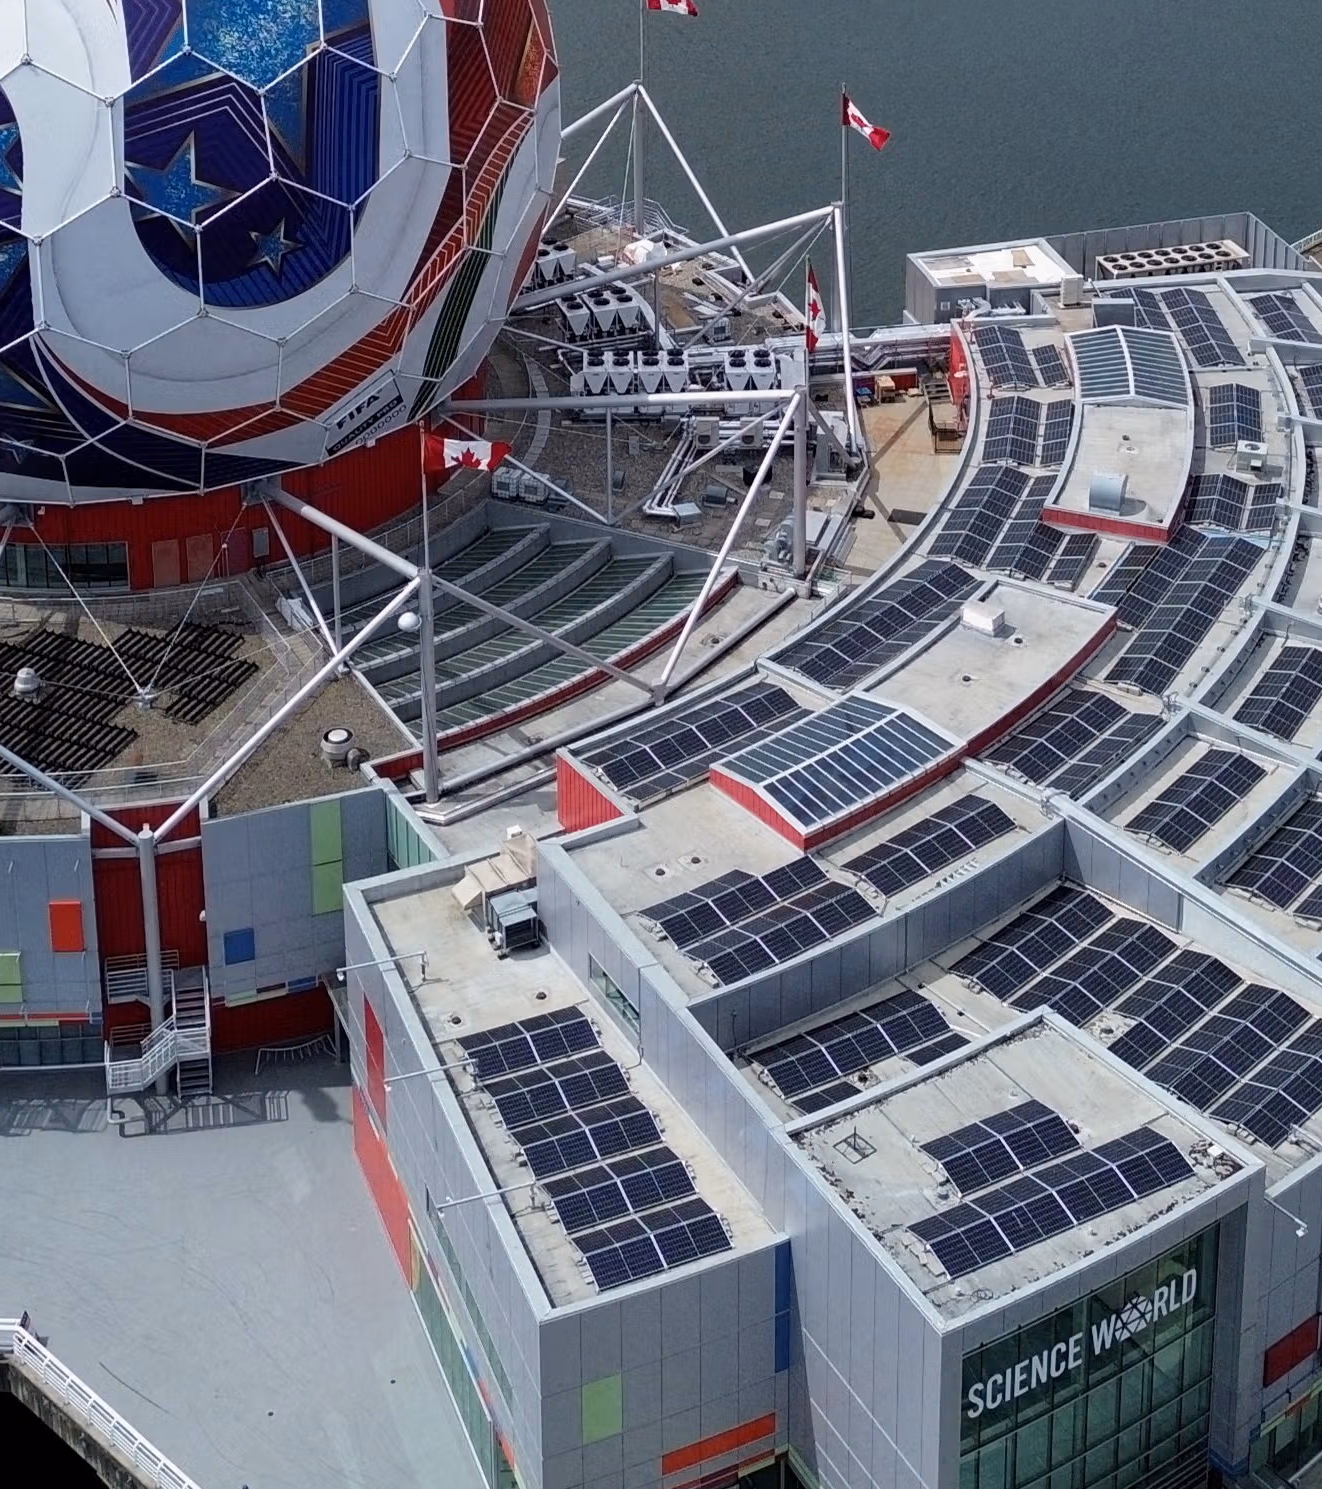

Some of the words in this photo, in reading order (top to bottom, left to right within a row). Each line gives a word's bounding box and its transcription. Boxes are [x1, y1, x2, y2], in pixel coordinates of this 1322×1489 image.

[332, 416, 376, 451] QUALITY
[377, 399, 398, 418] PRO
[336, 392, 380, 430] FIFA
[966, 1331, 1084, 1419] SCIENCE
[1091, 1267, 1197, 1356] WORLD
